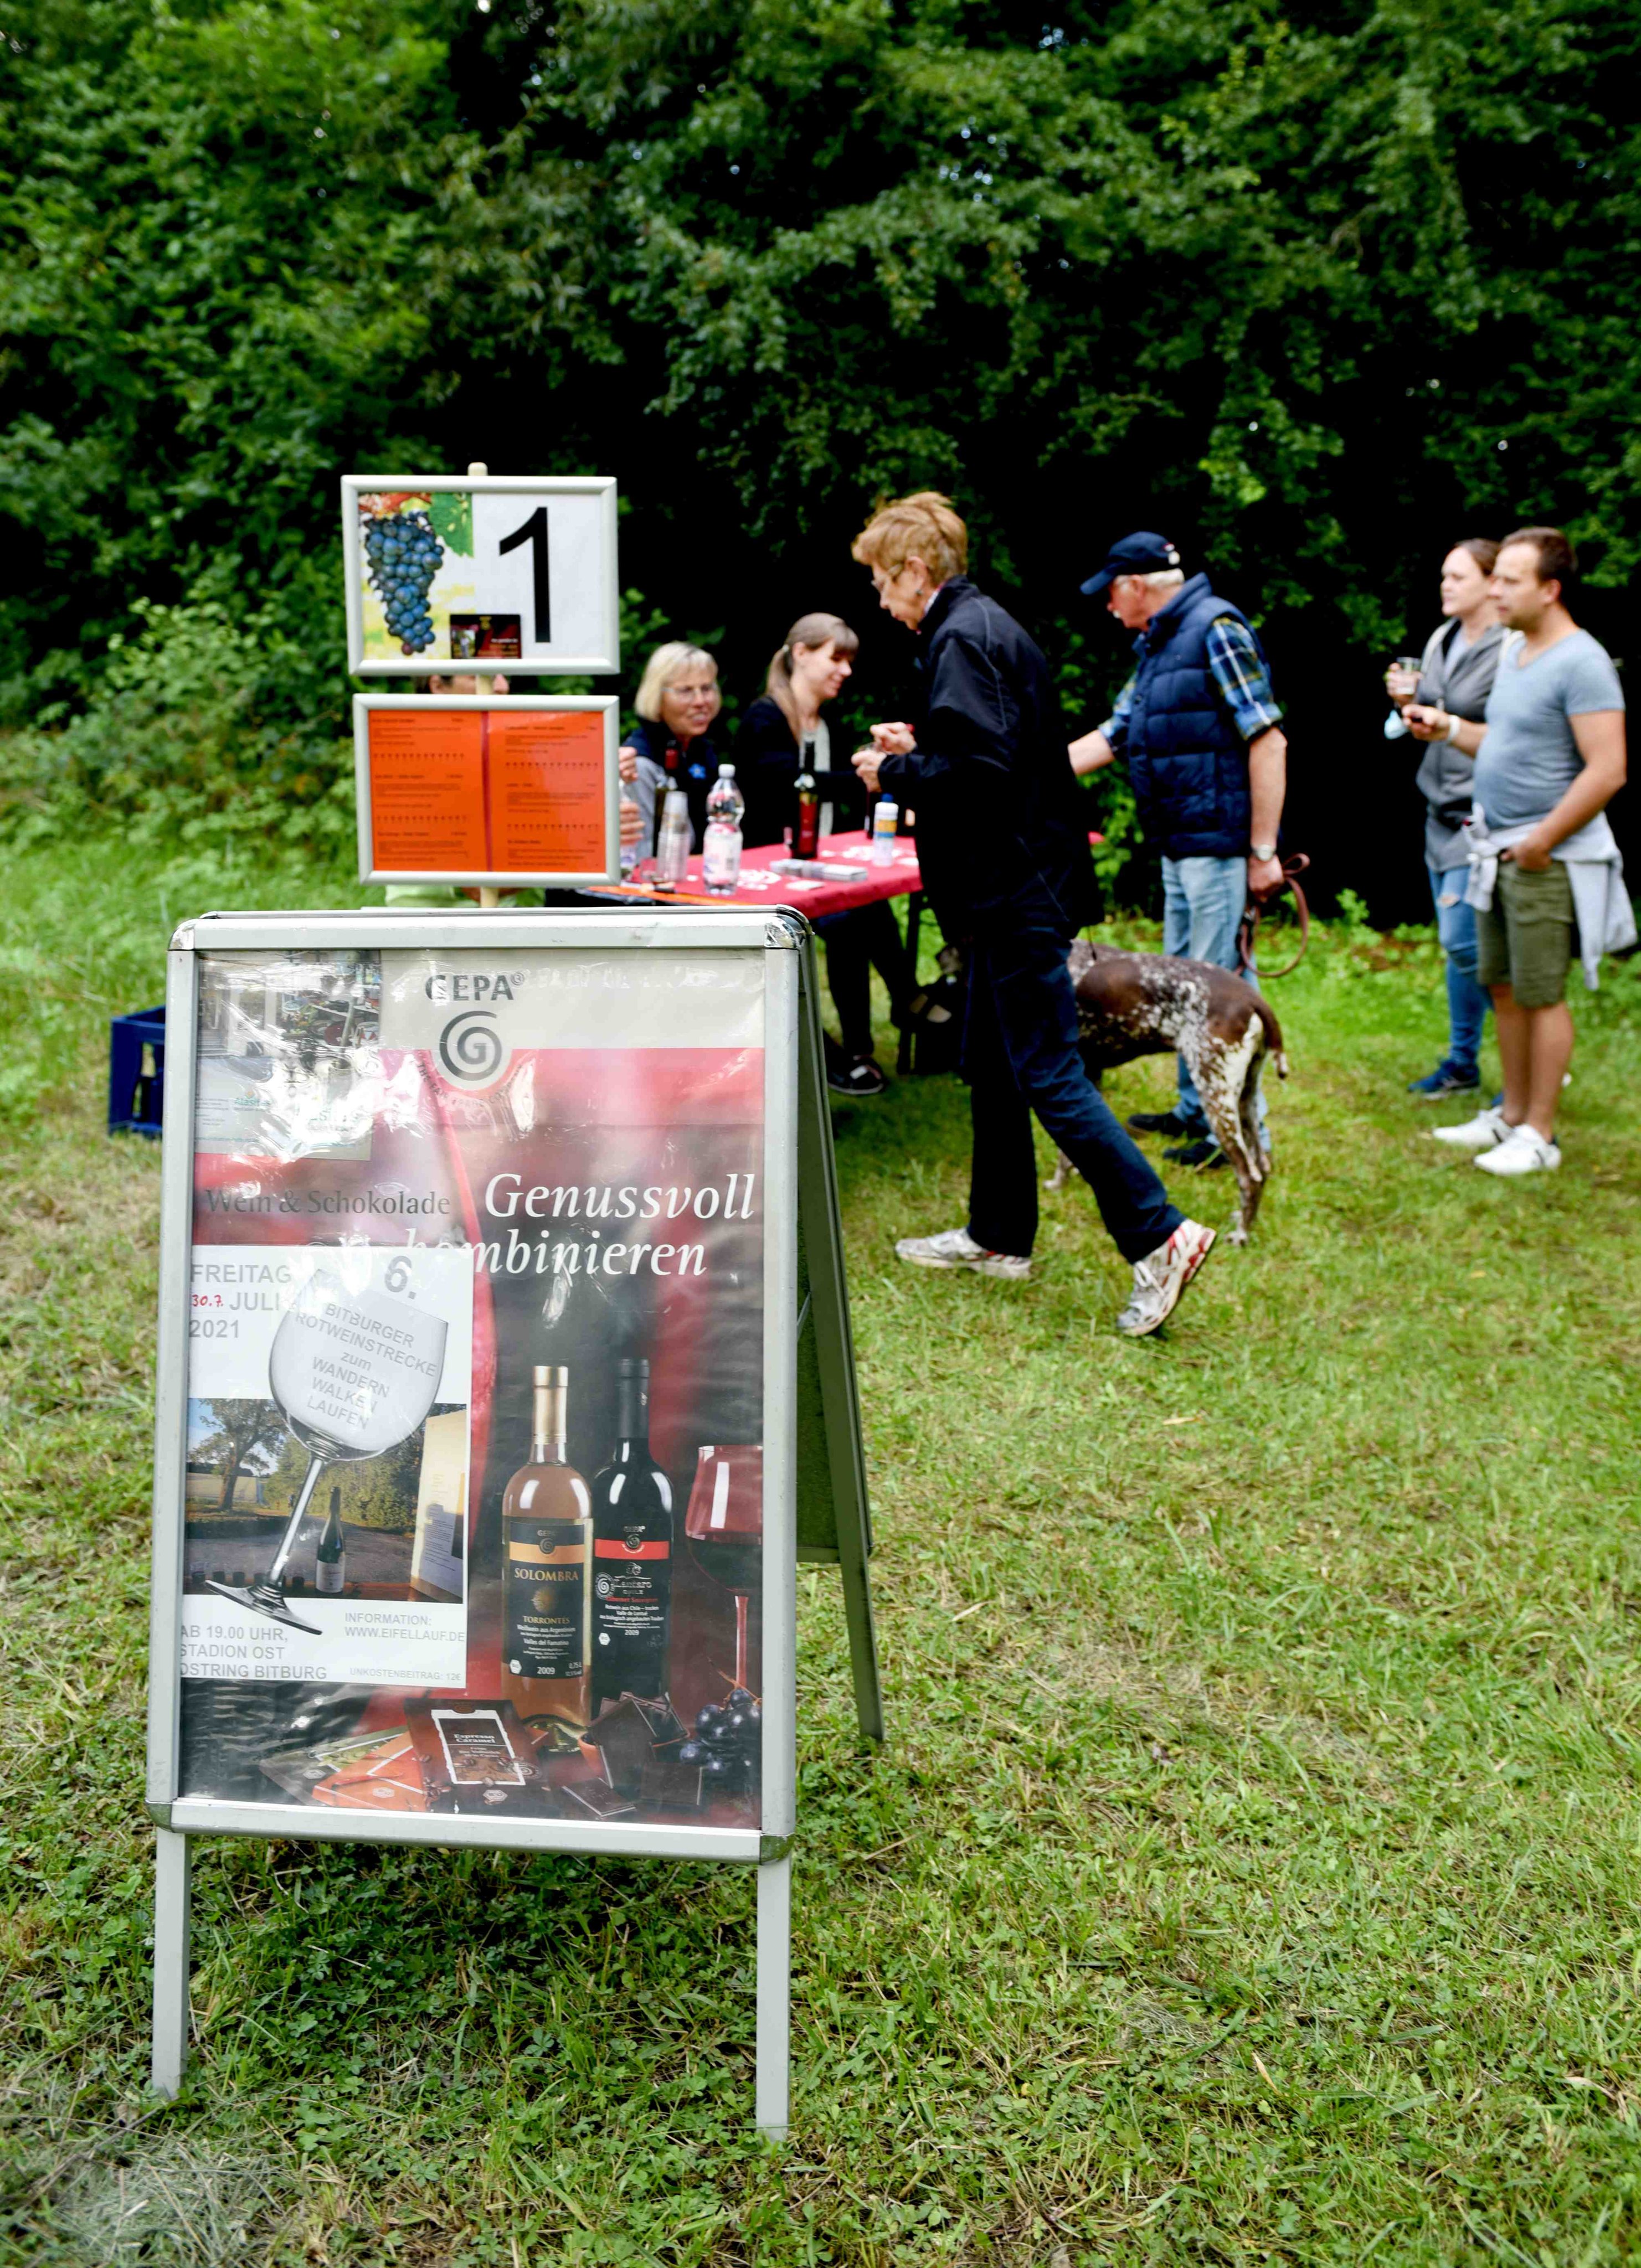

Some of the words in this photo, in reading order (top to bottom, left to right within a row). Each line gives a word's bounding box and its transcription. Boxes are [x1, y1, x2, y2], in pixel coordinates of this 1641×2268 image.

[499, 507, 551, 643] 1
[206, 1190, 271, 1213] Wein
[279, 1190, 302, 1213] &
[307, 1190, 450, 1214] Schokolade
[485, 1173, 756, 1219] Genussvoll
[407, 1228, 707, 1276] mbinieren
[191, 1265, 292, 1284] FREITAG
[385, 1255, 416, 1300] 6.
[229, 1292, 279, 1311] JULI
[189, 1319, 239, 1338] 2021
[326, 1303, 414, 1348] BITBURGER
[295, 1312, 438, 1377] ROTWEINSTRECKE
[341, 1352, 372, 1370] zum
[313, 1357, 389, 1398] WANDERN
[307, 1396, 369, 1430] LAUFEN
[514, 1568, 579, 1582] SOLOMBRA
[345, 1612, 432, 1626] INFORMATION:
[181, 1625, 200, 1638] AB
[207, 1626, 245, 1640] 19.00
[250, 1627, 288, 1642] UHR,
[344, 1626, 465, 1642] WWW.EIFELLAUF.DE
[181, 1644, 247, 1658] STADION
[253, 1646, 285, 1659] OST
[181, 1663, 249, 1677] OSTRING
[255, 1665, 327, 1679] BITBURG
[350, 1667, 444, 1680] UNKOSTENBEITRAG:
[446, 1672, 461, 1681] 12€
